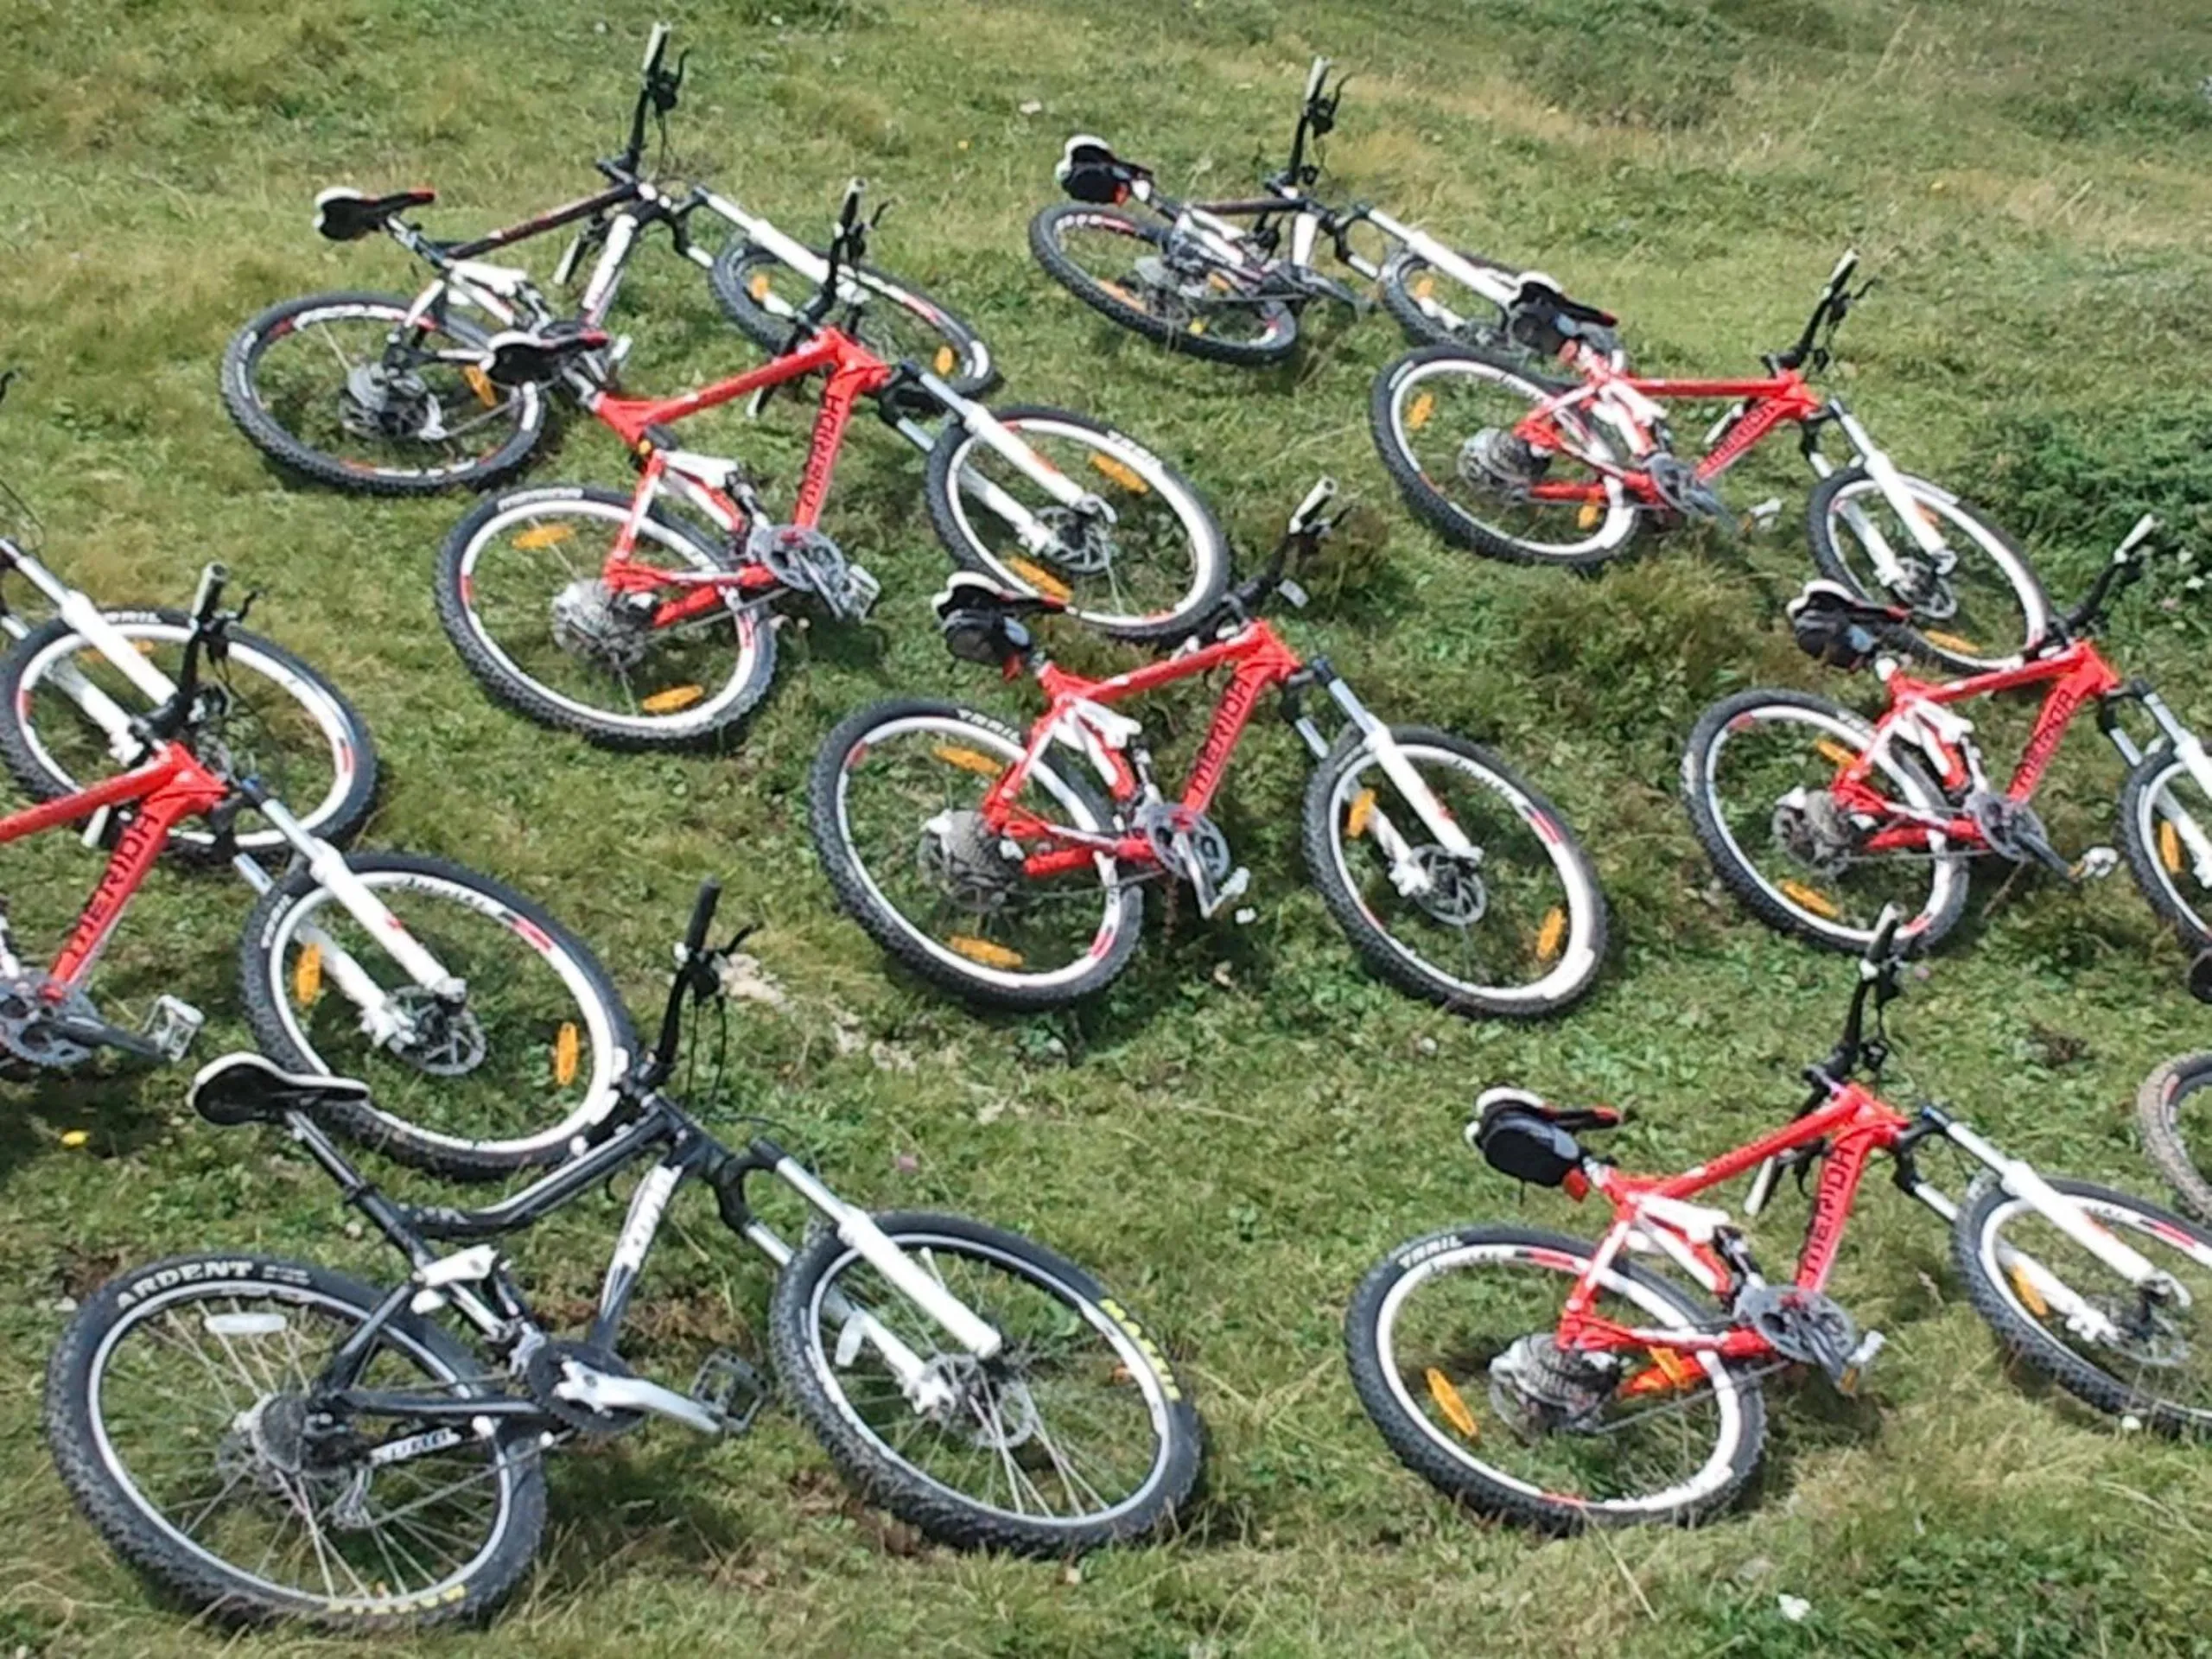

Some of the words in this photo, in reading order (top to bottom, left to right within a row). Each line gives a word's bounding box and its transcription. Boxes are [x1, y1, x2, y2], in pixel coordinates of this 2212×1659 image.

[1188, 671, 1254, 796] MERIDA
[67, 813, 161, 959] MERIDA
[1804, 1144, 1857, 1277] MERIDA
[118, 1260, 254, 1310] ARDENT
